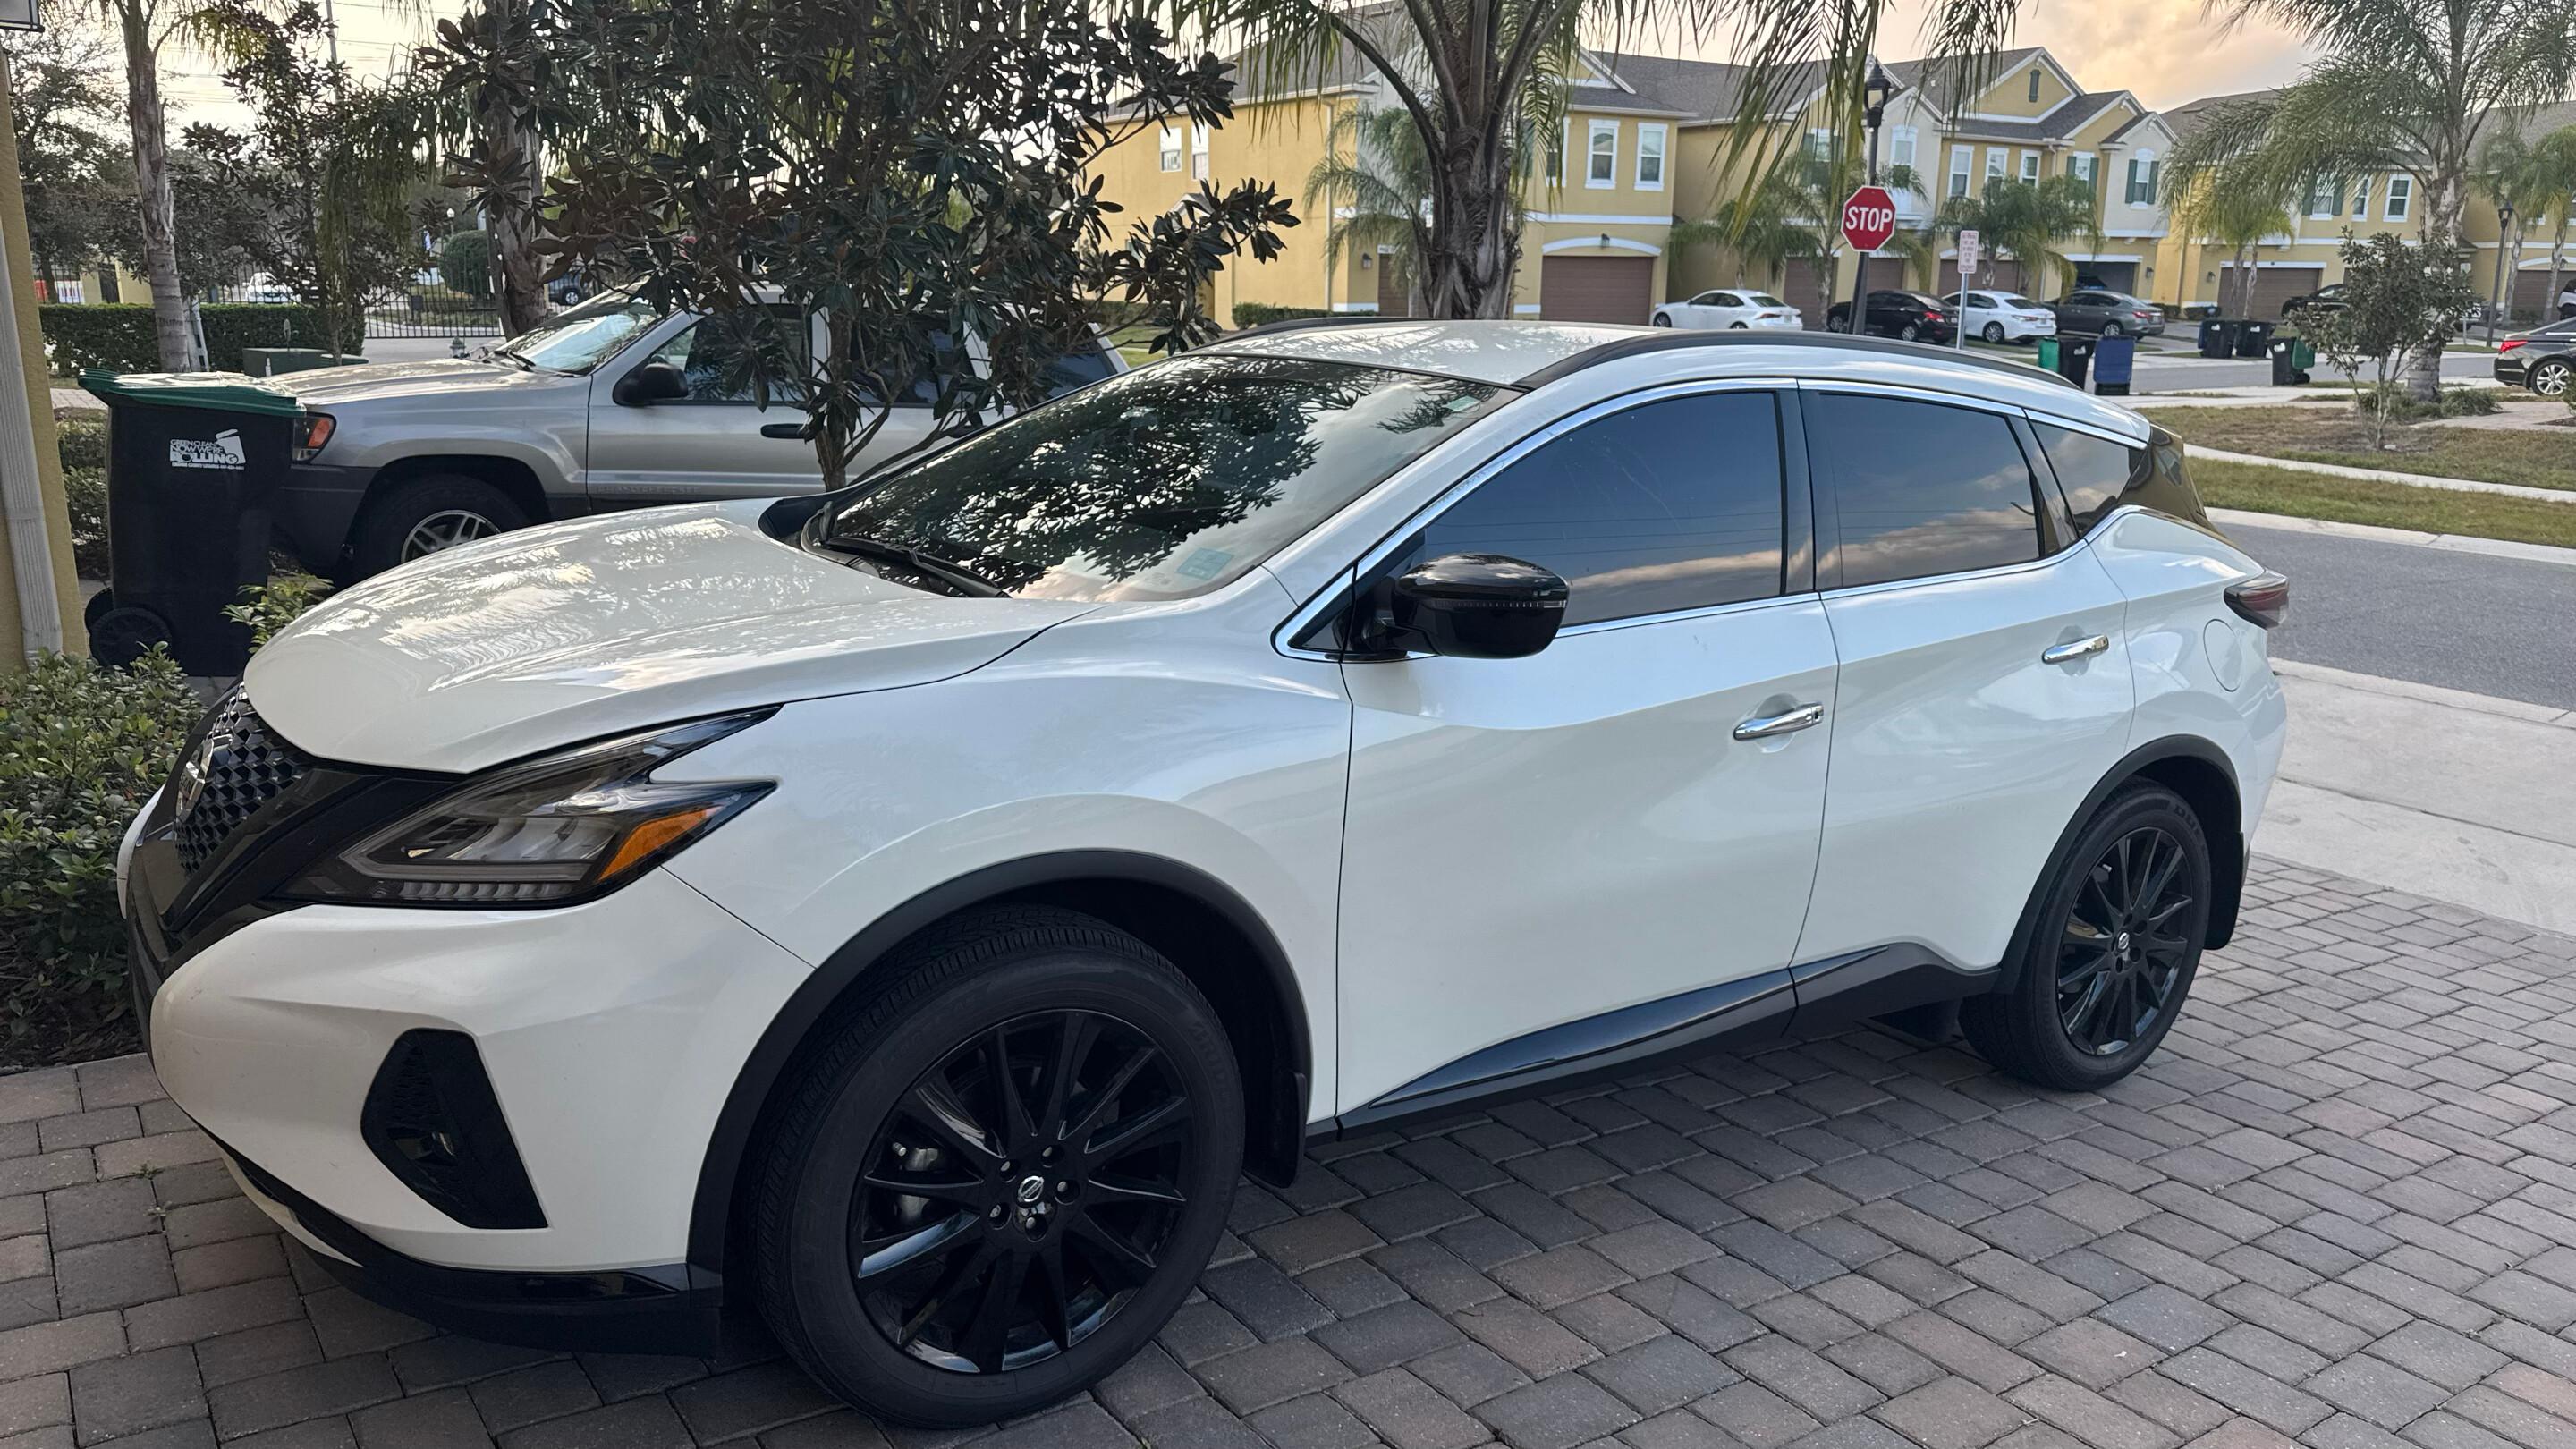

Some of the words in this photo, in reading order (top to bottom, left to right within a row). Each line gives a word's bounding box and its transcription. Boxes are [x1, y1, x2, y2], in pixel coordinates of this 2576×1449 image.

[1845, 206, 1893, 232] STOP
[170, 444, 197, 453] NOW
[170, 451, 239, 464] ROLLING
